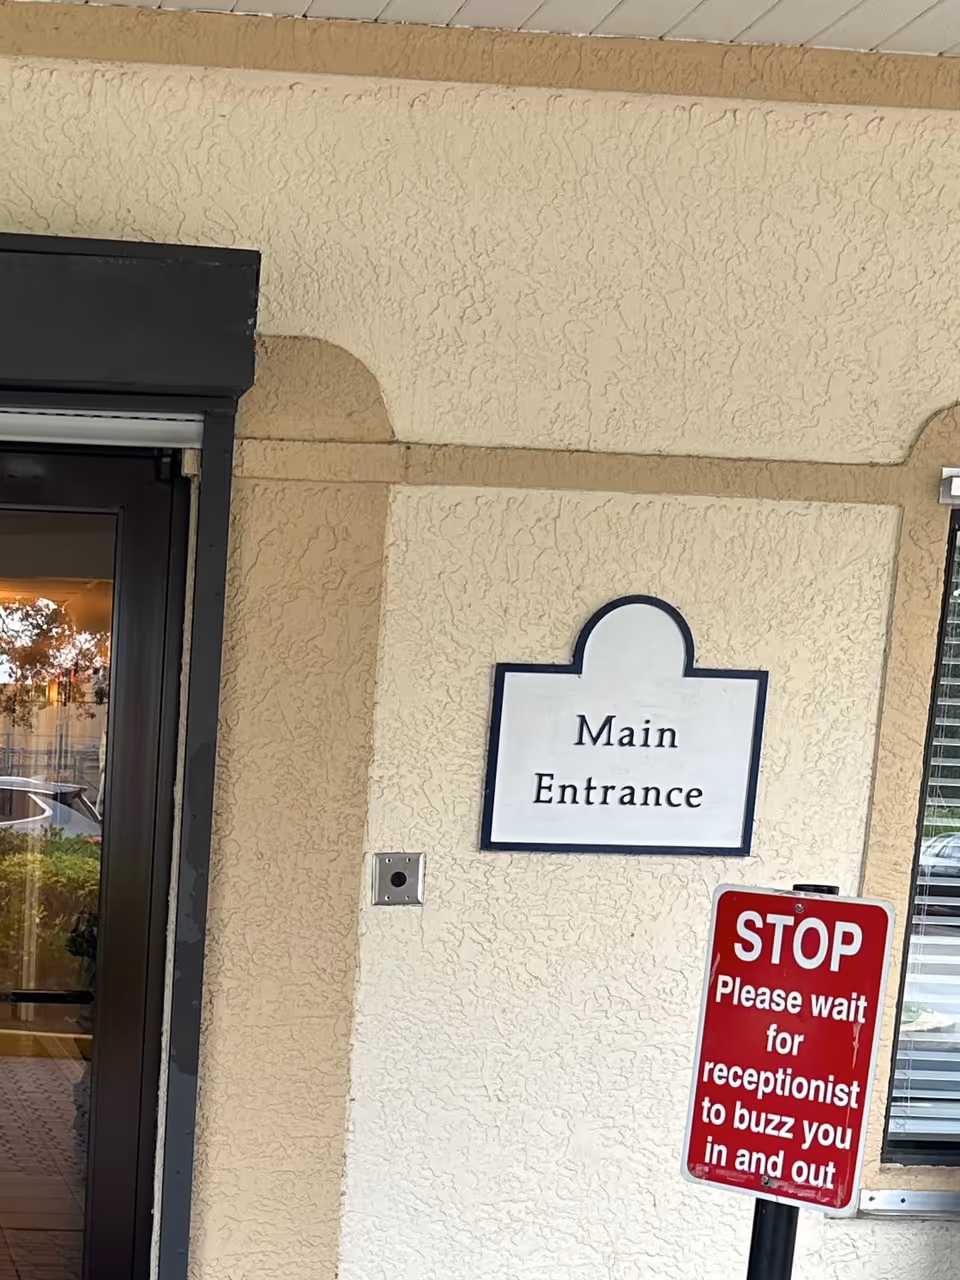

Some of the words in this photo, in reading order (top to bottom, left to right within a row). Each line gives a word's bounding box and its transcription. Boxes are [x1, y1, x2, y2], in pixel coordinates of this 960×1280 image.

[574, 714, 678, 748] Main
[533, 773, 703, 808] Entrance
[734, 910, 863, 972] STOP
[715, 974, 802, 1014] Please
[811, 992, 868, 1023] wait
[766, 1024, 804, 1056] for
[703, 1061, 860, 1109] receptionist
[702, 1097, 726, 1126] to
[733, 1101, 795, 1139] buzz
[801, 1119, 852, 1150] you
[704, 1136, 728, 1167] in
[735, 1148, 785, 1178] and
[791, 1160, 836, 1189] out
